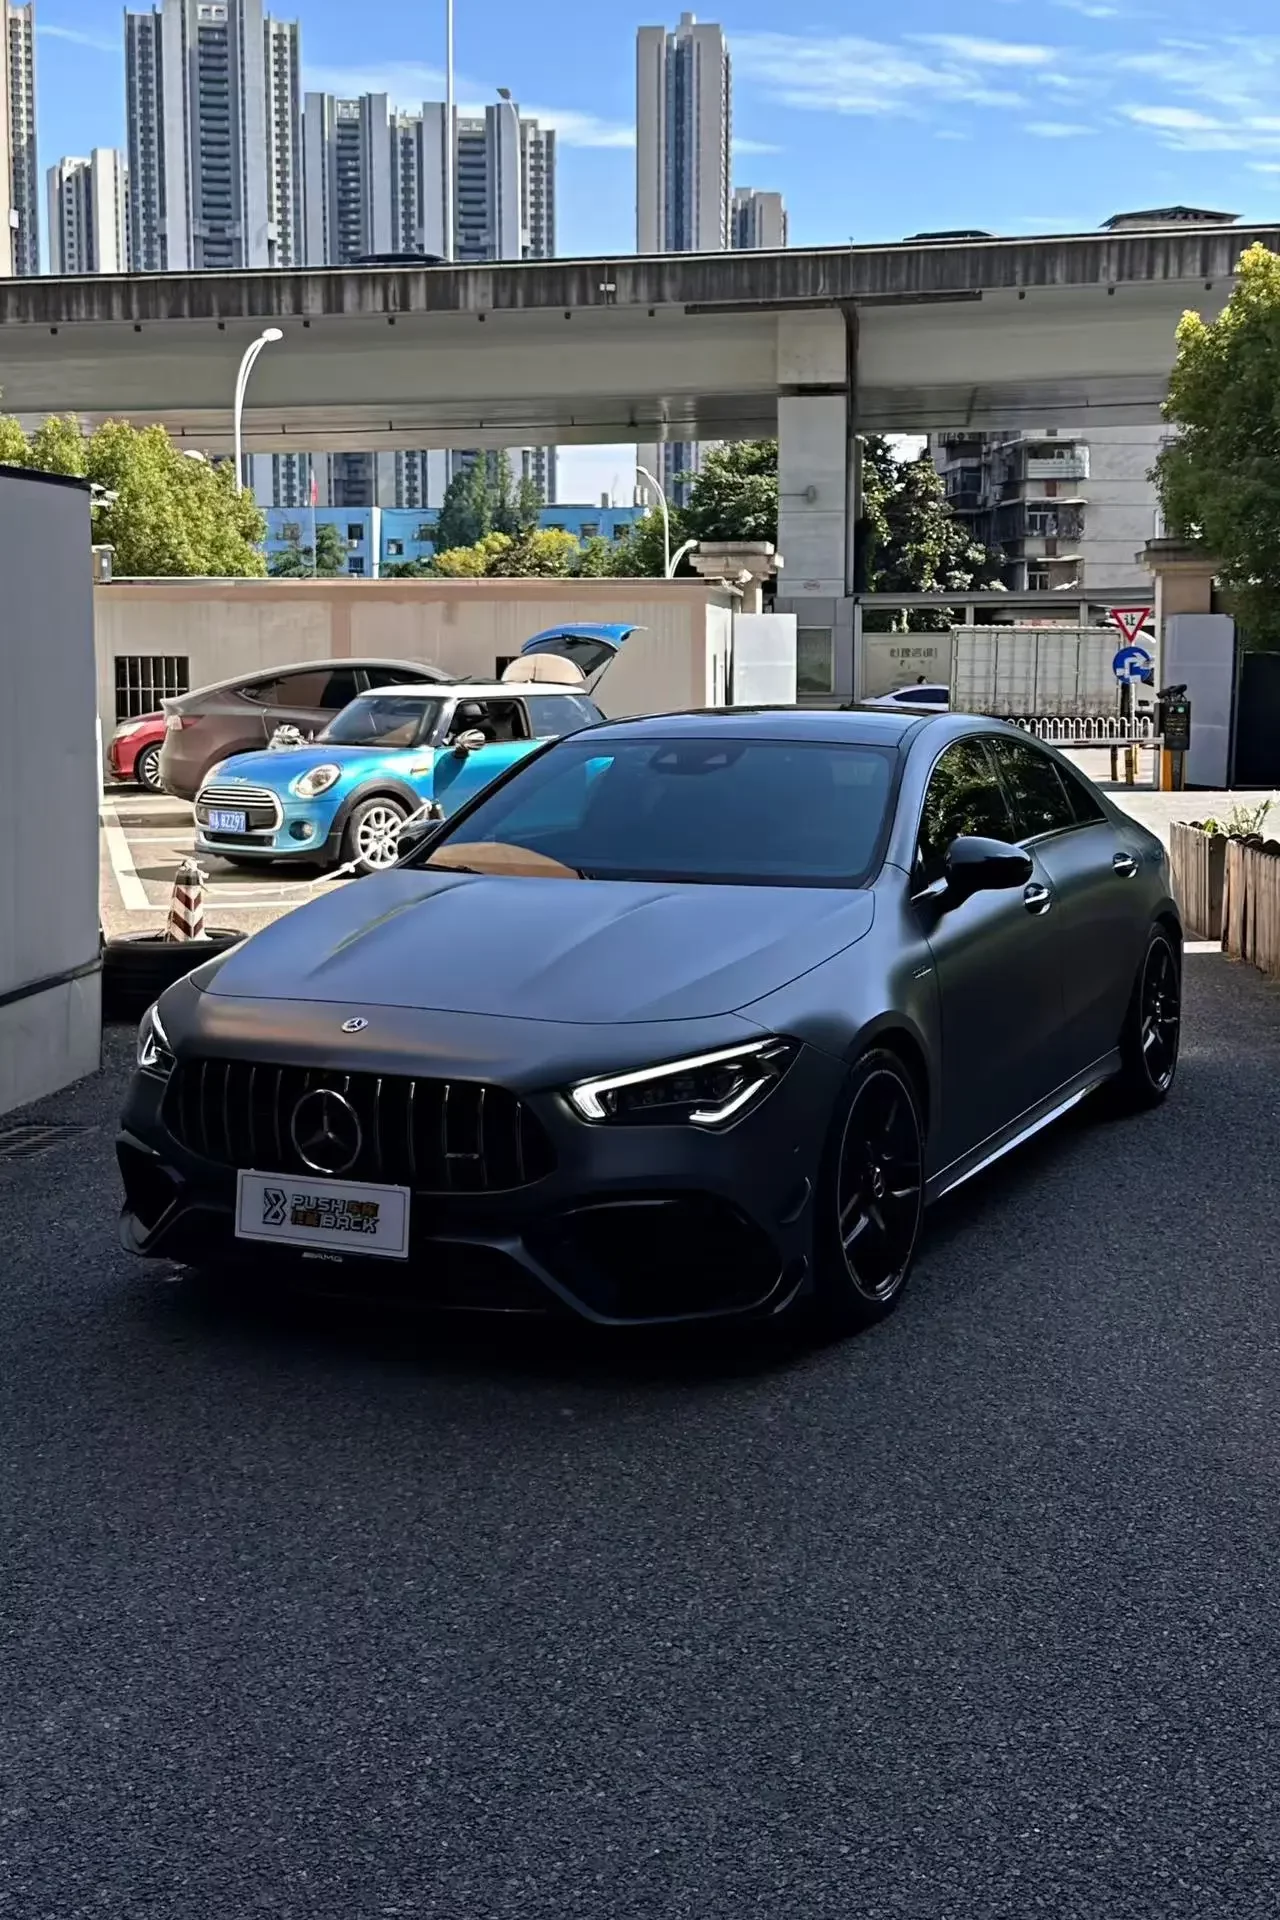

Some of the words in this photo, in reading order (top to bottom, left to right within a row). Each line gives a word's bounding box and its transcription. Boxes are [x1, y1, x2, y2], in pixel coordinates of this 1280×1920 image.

[1124, 613, 1136, 626] 让
[291, 1194, 346, 1214] PUSH
[319, 1213, 379, 1233] BACK
